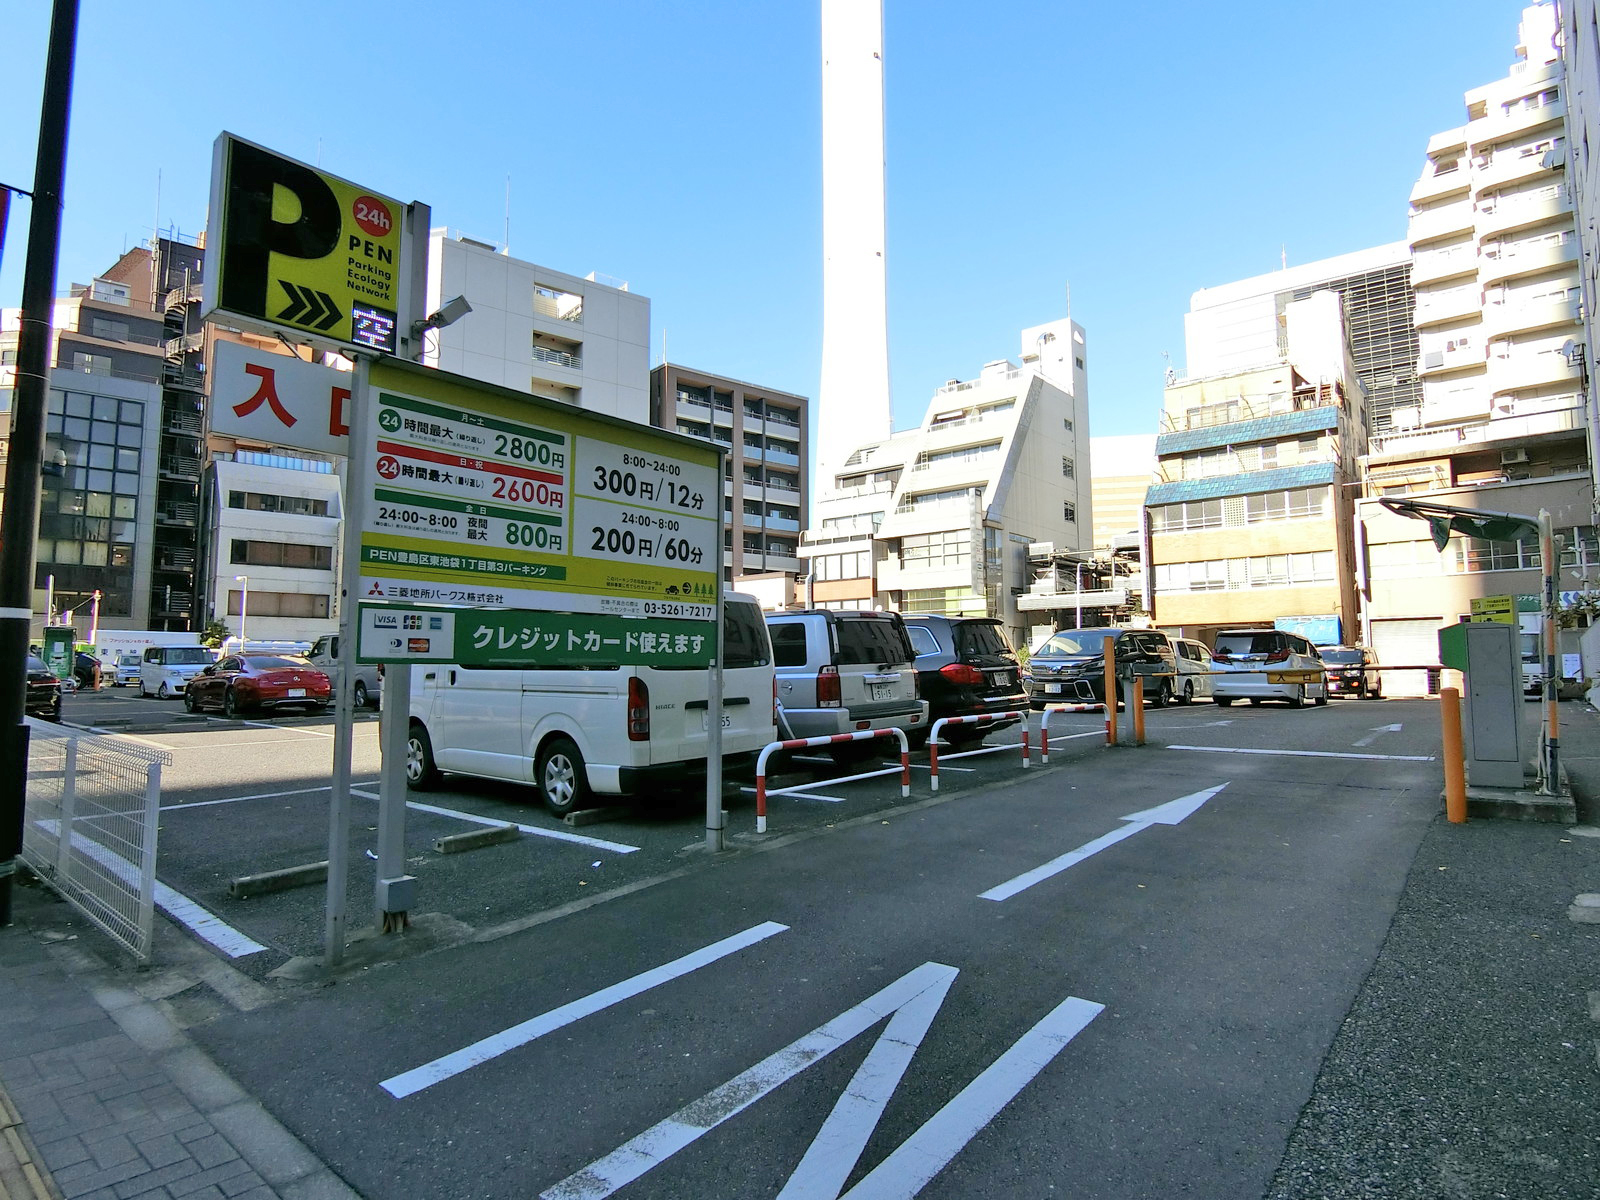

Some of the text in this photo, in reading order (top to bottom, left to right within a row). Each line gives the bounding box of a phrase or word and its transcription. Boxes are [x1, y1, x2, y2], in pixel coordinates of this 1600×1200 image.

[220, 138, 342, 318] P
[355, 203, 390, 231] 24h
[349, 234, 393, 265] PEN
[347, 269, 391, 291] Ecology
[348, 257, 392, 281] Parking
[347, 280, 390, 301] Network
[353, 310, 394, 352] 空
[494, 434, 564, 469] 2800円
[492, 476, 564, 508] 2600円
[467, 517, 488, 529] 夜間
[467, 529, 488, 541] 最大
[505, 522, 562, 551] 800円
[388, 586, 504, 604] 三菱地所パークス株式会社
[377, 615, 397, 624] VISA
[644, 603, 711, 617] 03-5261-7217
[473, 625, 705, 654] クレジットカード使えます
